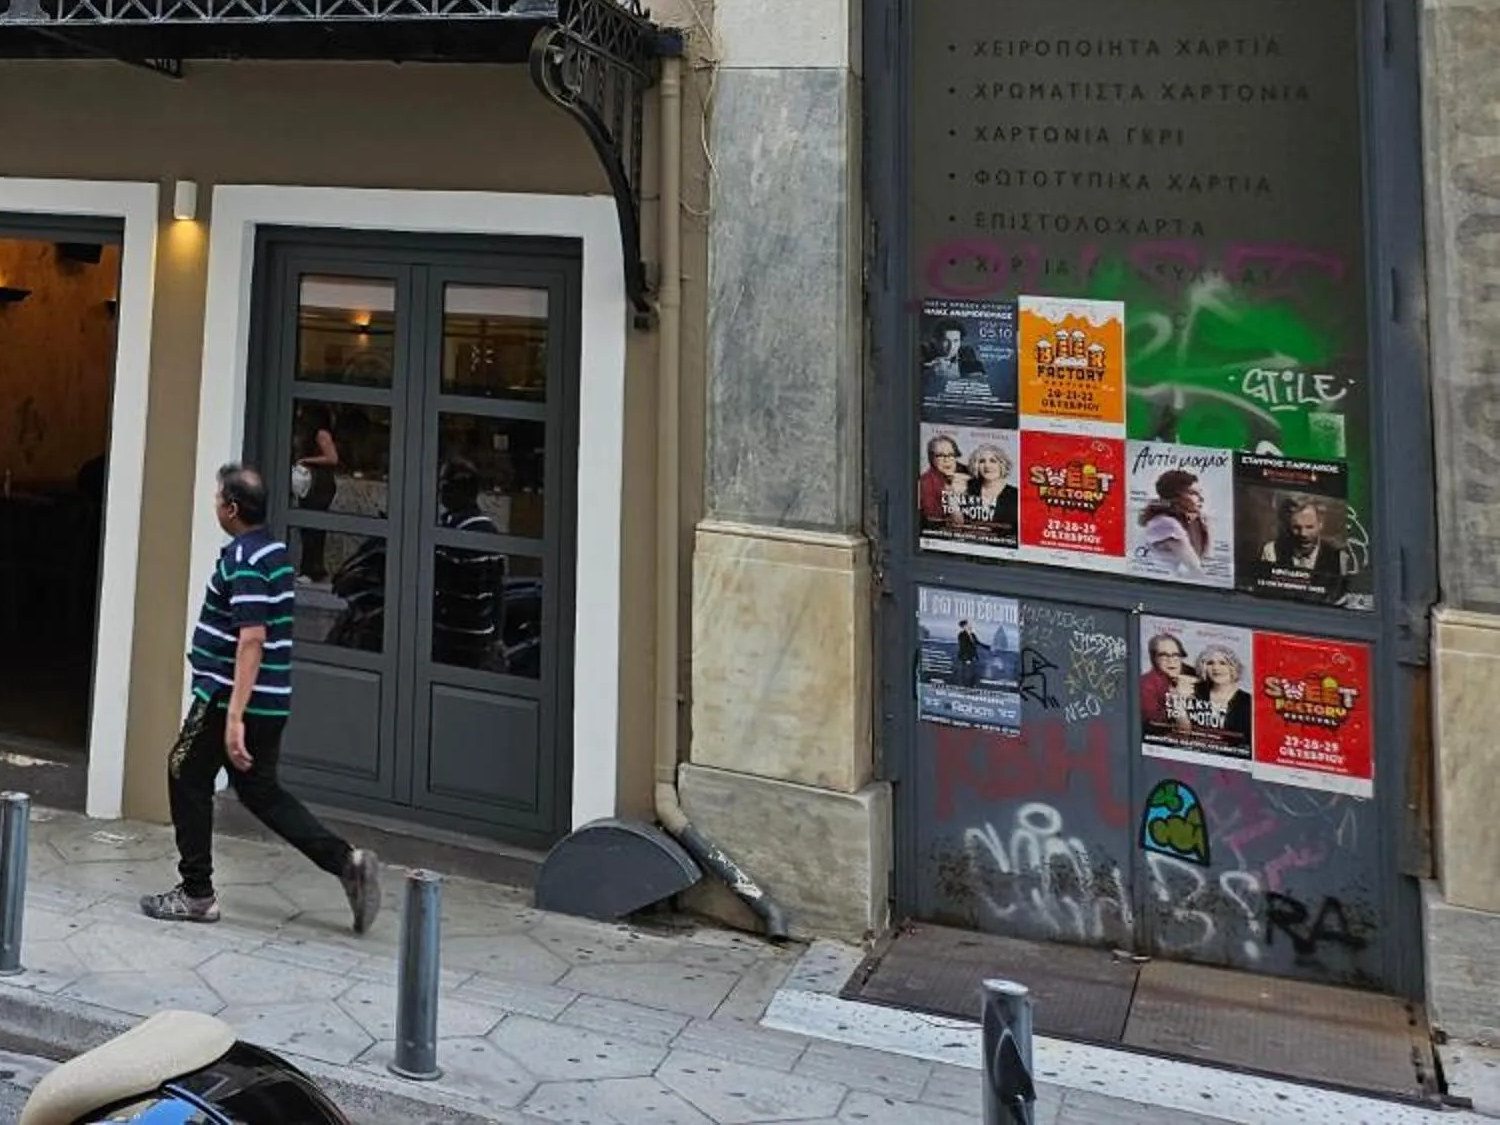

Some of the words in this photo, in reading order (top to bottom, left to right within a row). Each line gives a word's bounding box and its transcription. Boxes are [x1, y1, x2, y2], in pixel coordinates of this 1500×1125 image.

[973, 40, 1161, 58] ΧΕΙΡΟΠΟΙΗΤΑ
[1176, 39, 1282, 57] ΧΑΡΤΙΑ
[973, 83, 1145, 102] ΧΡΩΜΑΤΙΣΤΑ
[1161, 83, 1311, 103] ΧΑΡΤΟΝΙΑ
[973, 126, 1111, 145] ΧΑΡΤΟΝΙΑ
[1126, 128, 1184, 147] ΓΚΡΙ
[973, 169, 1151, 192] ΦΩΤΟΤΥΠΙΚΑ
[1167, 173, 1272, 194] ΧΑΡΤΙΑ
[973, 212, 1206, 236] ΕΠΙΣΤΟΛΟΧΑΡΤΑ
[1037, 365, 1106, 382] FACTORY
[1029, 463, 1115, 492] SWEET
[1039, 486, 1104, 502] FACTORY
[1263, 676, 1360, 708] SWEET
[1275, 698, 1349, 718] FACTORY
